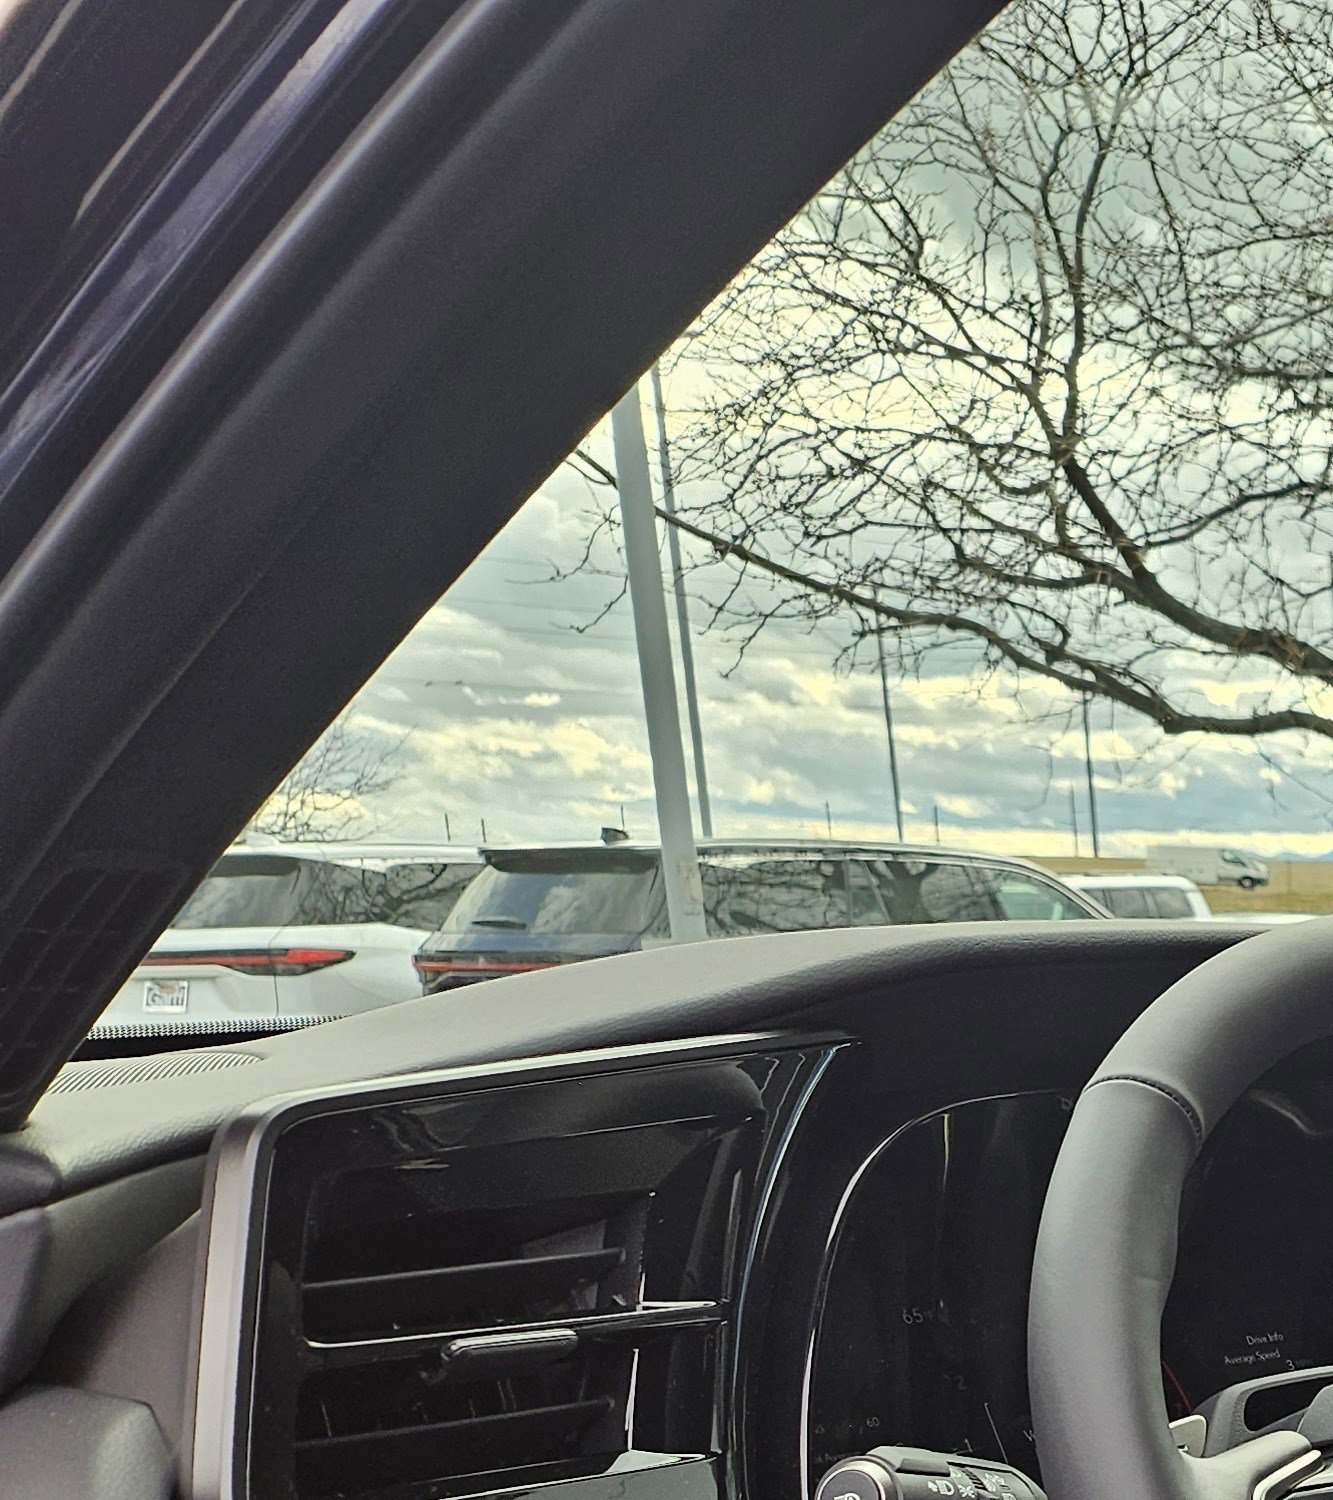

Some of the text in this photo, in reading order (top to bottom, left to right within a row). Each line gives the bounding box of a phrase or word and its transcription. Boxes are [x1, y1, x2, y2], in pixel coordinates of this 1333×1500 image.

[1246, 1331, 1284, 1346] Drive Info
[1255, 1349, 1281, 1362] Speed
